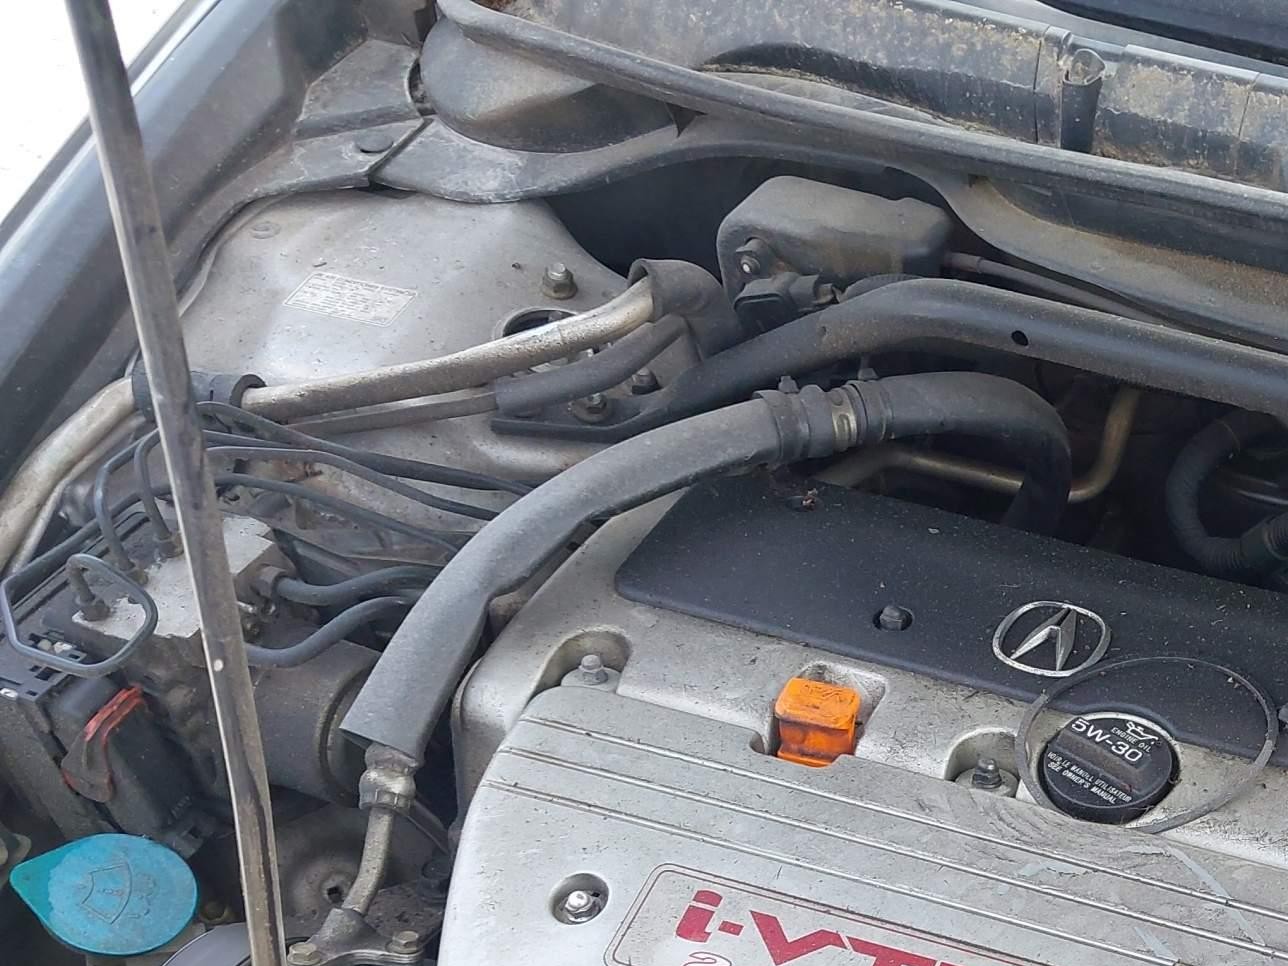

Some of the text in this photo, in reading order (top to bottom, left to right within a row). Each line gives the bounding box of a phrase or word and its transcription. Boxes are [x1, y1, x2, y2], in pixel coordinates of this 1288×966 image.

[1071, 718, 1143, 762] 5W-30
[1111, 727, 1152, 752] ENGINE OIL
[1048, 761, 1117, 804] SEE OWNER'S MANUAL
